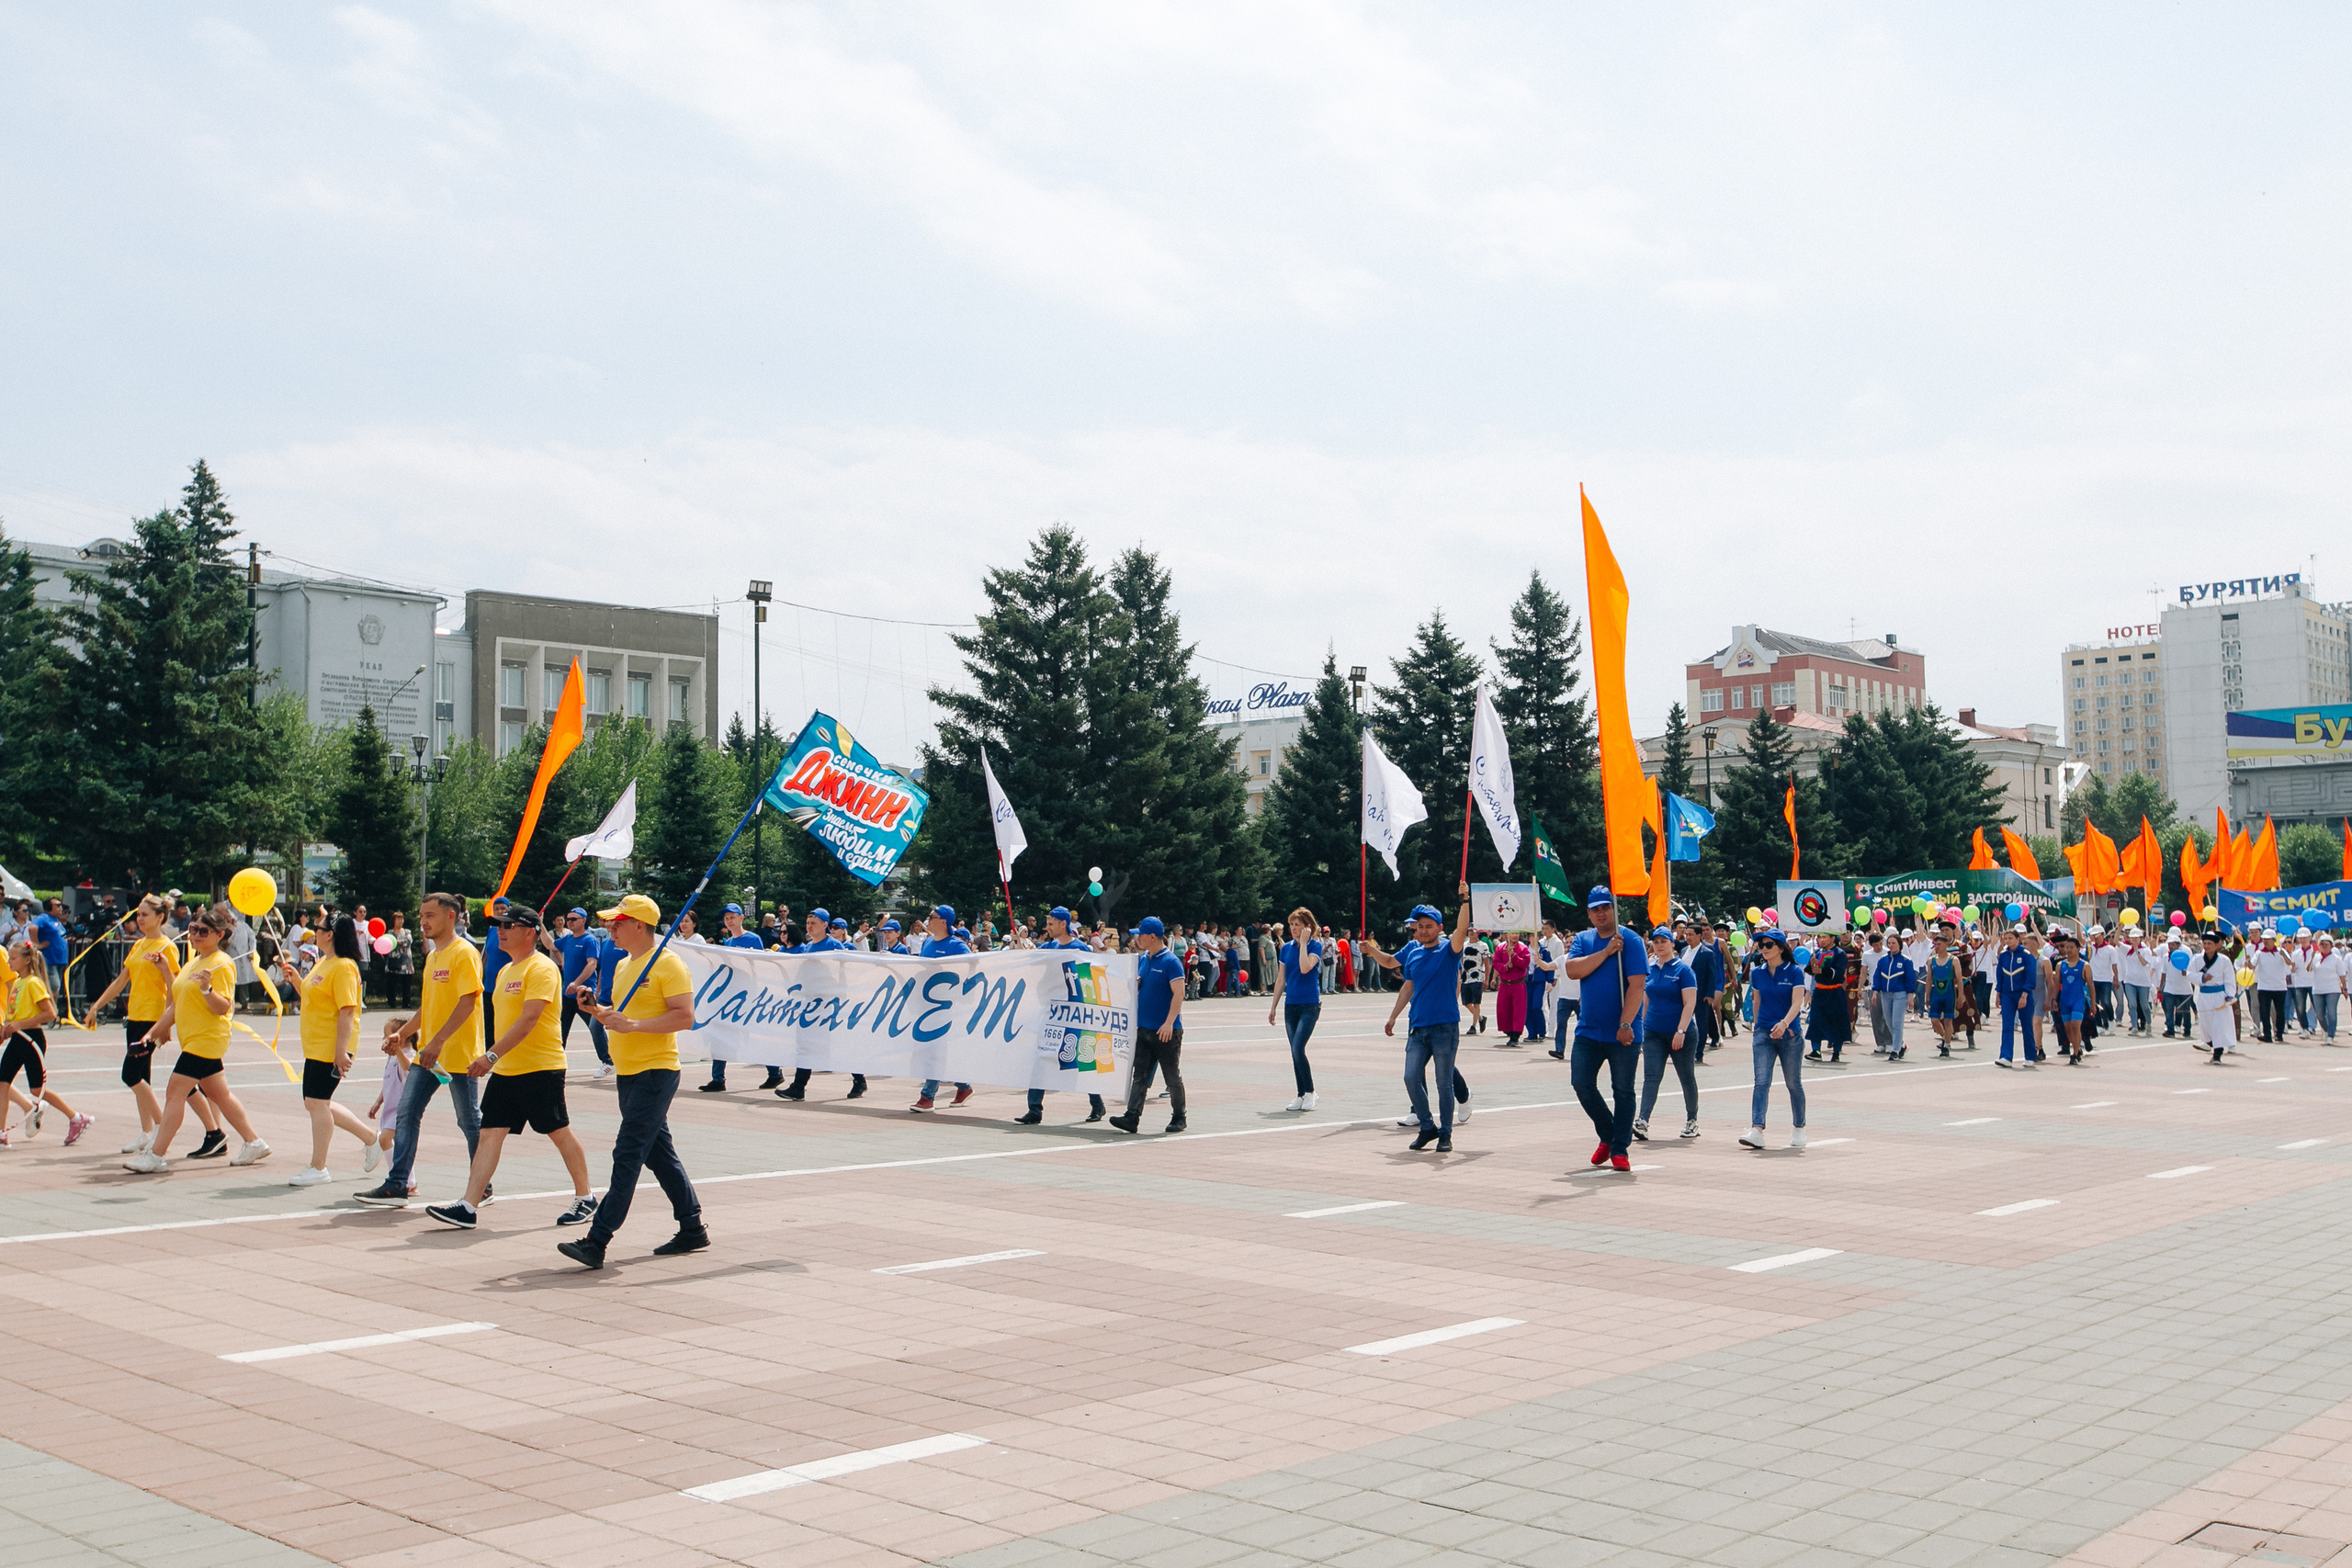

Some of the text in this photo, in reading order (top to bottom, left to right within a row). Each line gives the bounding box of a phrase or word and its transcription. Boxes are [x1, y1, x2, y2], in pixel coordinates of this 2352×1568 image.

[2179, 572, 2301, 603] БУРЯТИЯ
[832, 754, 894, 784] семечки
[821, 807, 854, 834] Знаем,
[836, 847, 897, 876] и едим!
[1874, 878, 1957, 895] СмитИнвест
[1882, 891, 1961, 909] ЗДОРВЫЙ
[2268, 887, 2341, 911] СМИТ
[1048, 1003, 1129, 1033] УЛАН-УДЭ
[1044, 1027, 1063, 1040] 1666
[1058, 1032, 1114, 1066] 356
